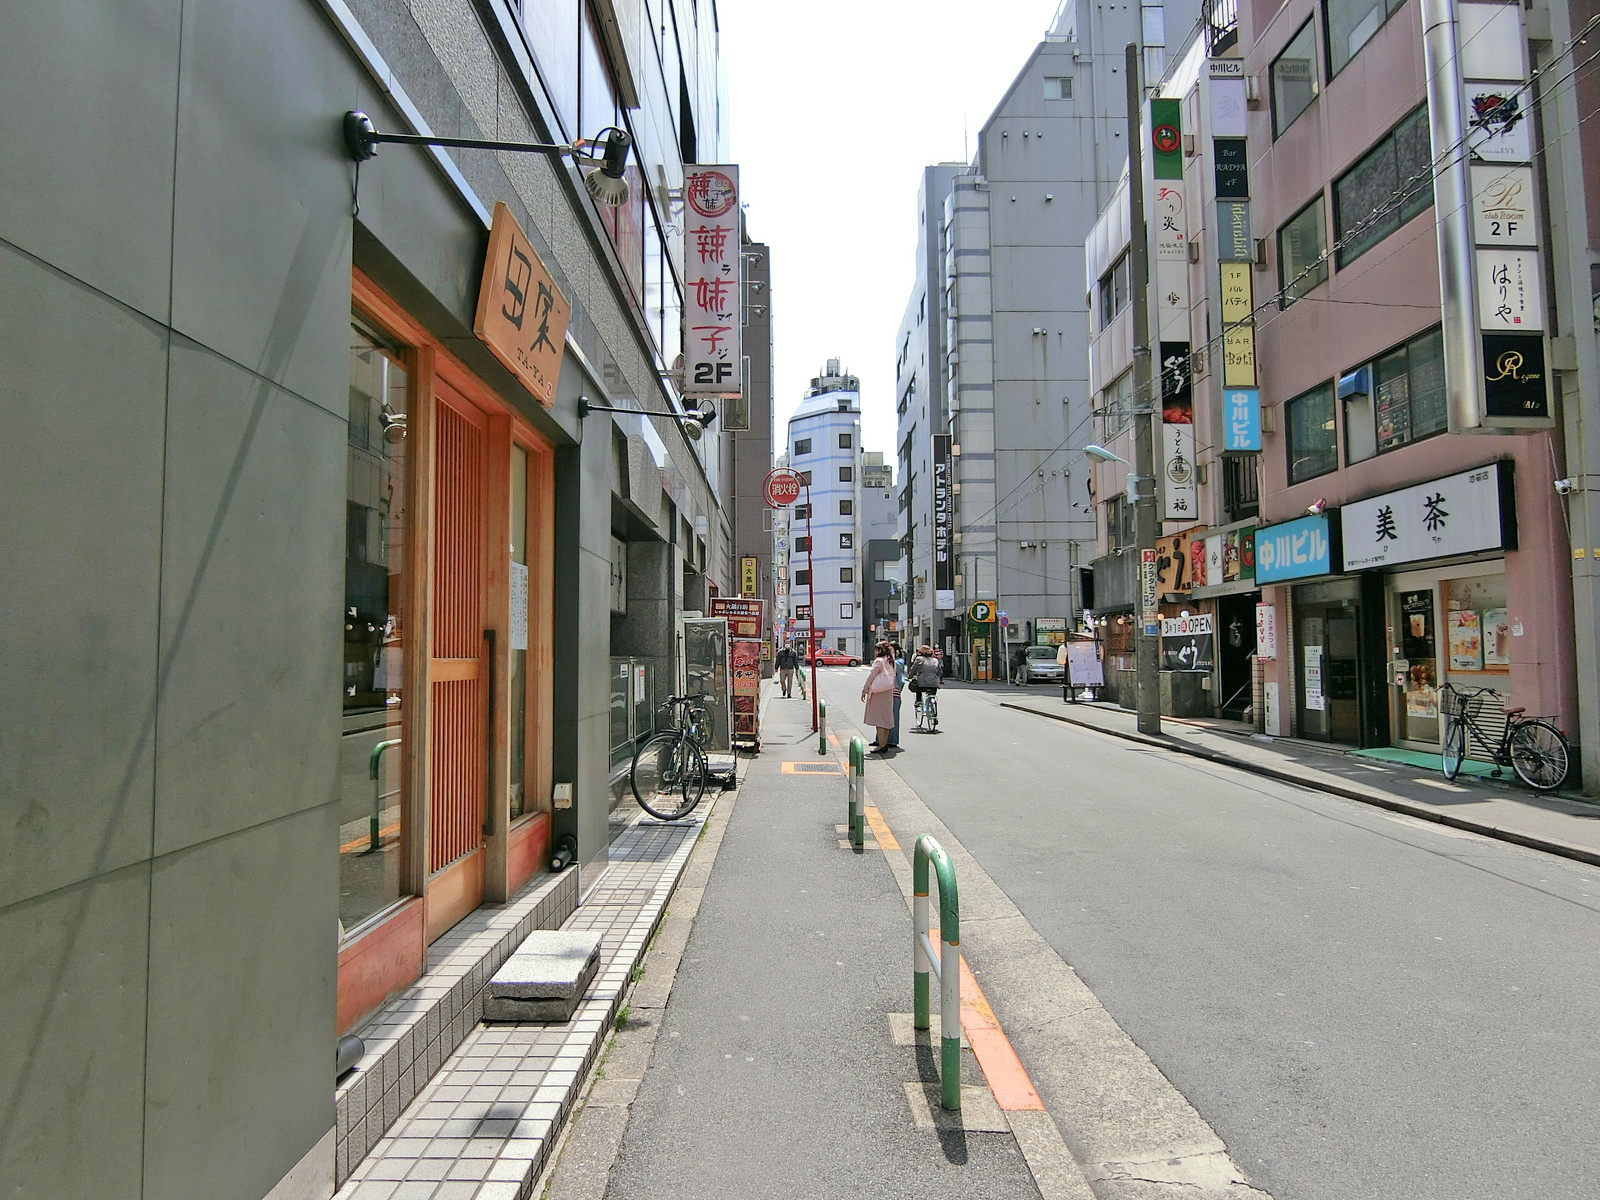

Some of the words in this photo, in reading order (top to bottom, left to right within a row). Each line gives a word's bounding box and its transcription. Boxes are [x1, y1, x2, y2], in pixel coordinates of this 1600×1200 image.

[1210, 63, 1240, 73] 中川ビル
[1222, 149, 1237, 157] Bar
[1500, 211, 1524, 219] Room
[1491, 222, 1517, 235] 2F
[1493, 264, 1512, 323] はりや
[517, 347, 545, 387] TA-YA
[694, 362, 732, 383] 2F
[1231, 392, 1251, 448] 中川ビル
[772, 483, 798, 495] 消火栓
[1173, 486, 1188, 511] 一福
[935, 463, 947, 562] アトランタホテル
[1259, 529, 1327, 571] 中川ビル
[1188, 617, 1212, 632] OPEN
[1178, 638, 1198, 669] ぐう
